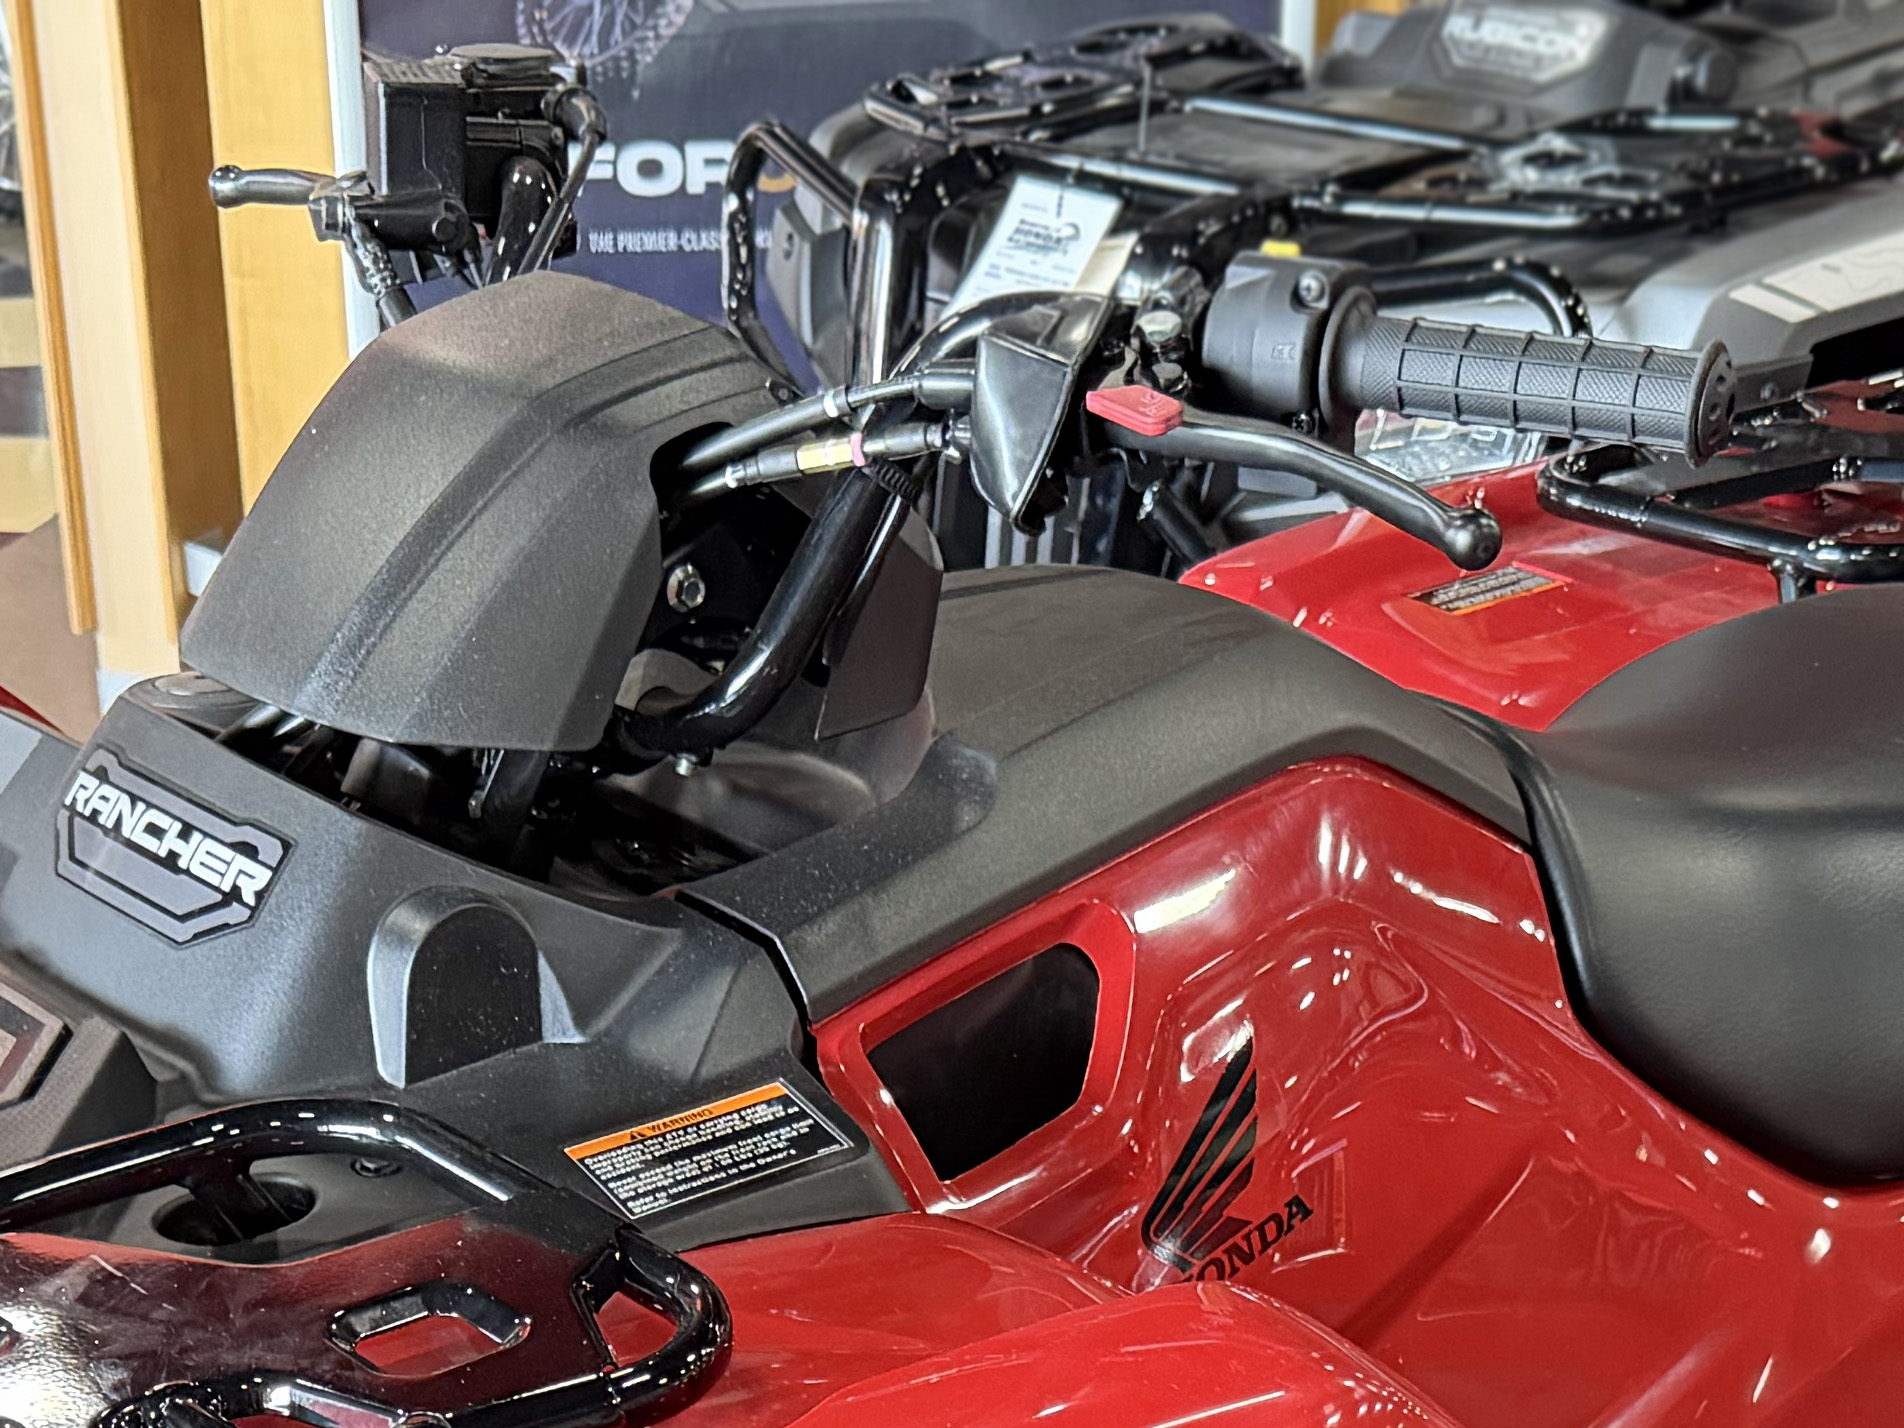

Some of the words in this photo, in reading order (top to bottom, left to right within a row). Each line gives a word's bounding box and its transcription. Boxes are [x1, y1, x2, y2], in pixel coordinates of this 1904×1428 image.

[63, 770, 274, 906] RANCHER
[645, 1107, 714, 1134] WARNING
[1180, 1194, 1314, 1282] ONDA
